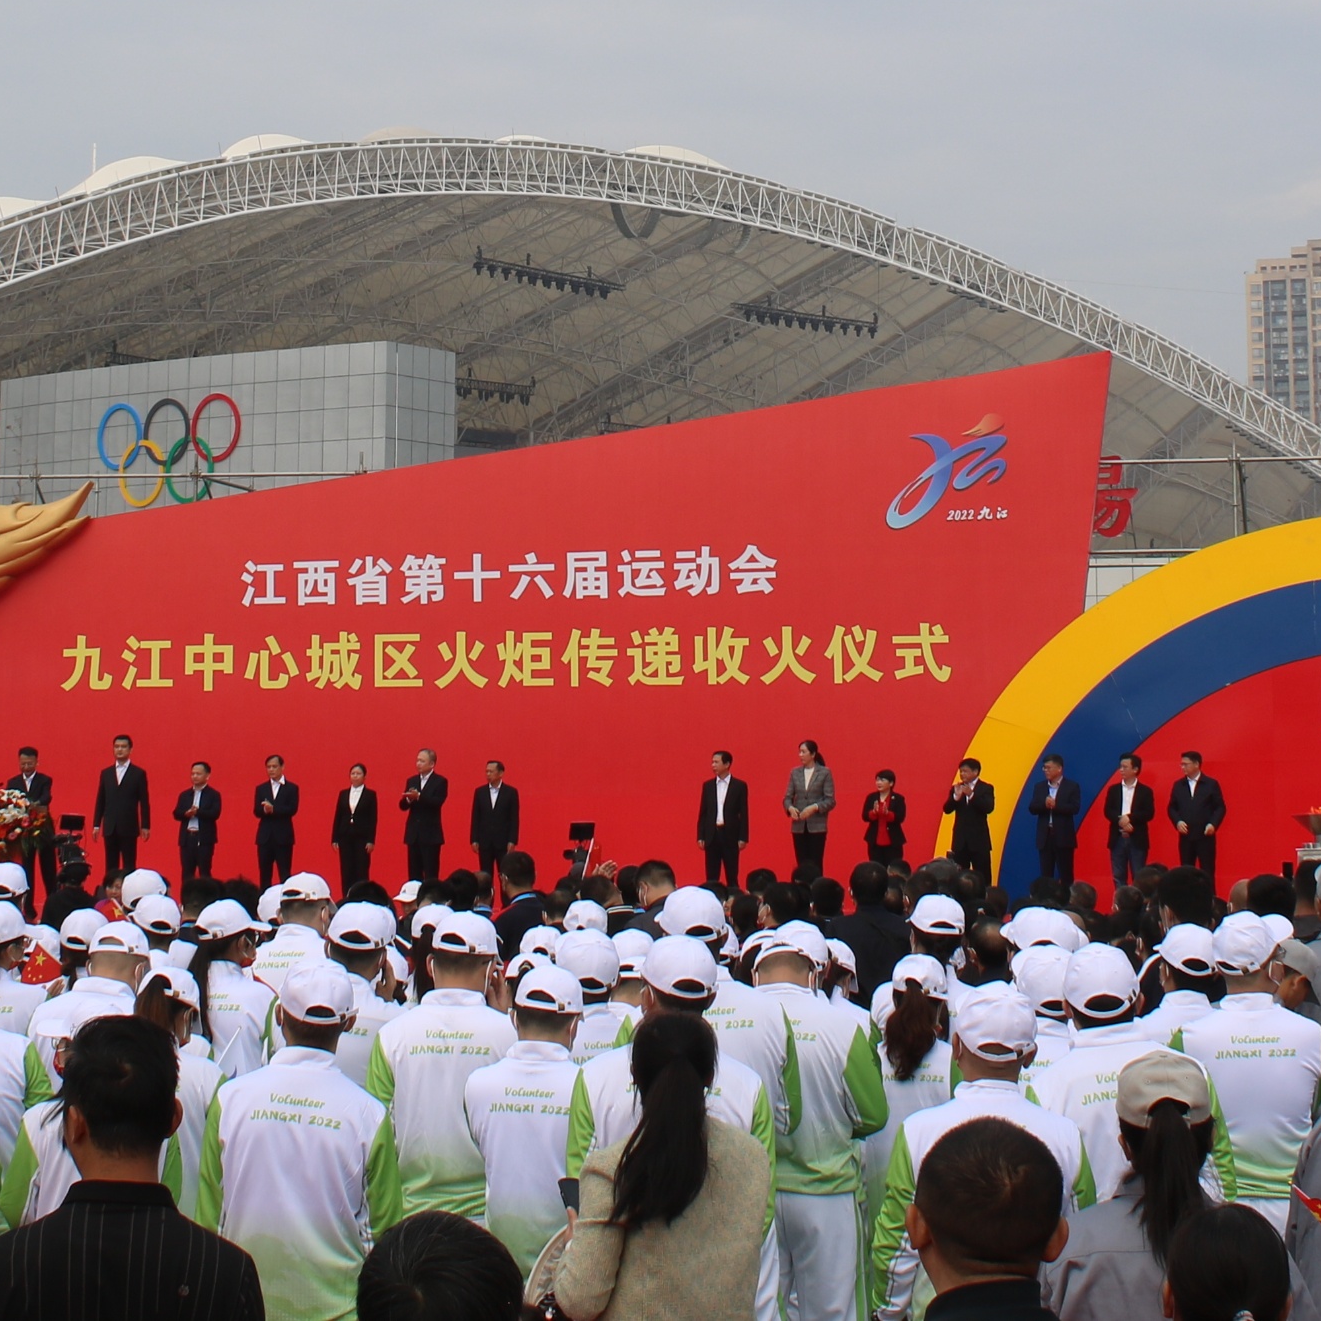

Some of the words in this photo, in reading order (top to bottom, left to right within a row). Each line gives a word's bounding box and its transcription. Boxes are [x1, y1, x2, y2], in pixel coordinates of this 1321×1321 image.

[946, 509, 975, 521] 2022
[241, 544, 777, 607] 江西省第十六届运动会
[60, 622, 952, 691] 九江中心城区火炬传递收火仪式
[268, 950, 306, 958] Volunteer
[255, 961, 290, 969] JIANGXI
[725, 1019, 754, 1029] 2022
[425, 1029, 474, 1040] Volunteer
[1231, 1035, 1280, 1045] Volunteer
[410, 1045, 454, 1055] JIANGXI
[461, 1046, 490, 1056] 2022
[1215, 1049, 1262, 1059] JIANGXI
[1269, 1048, 1297, 1057] 2022
[919, 1074, 944, 1082] 2022
[504, 1086, 555, 1099] Volunteer
[270, 1093, 326, 1109] Volunteer
[489, 1103, 534, 1114] JIANGXI
[541, 1105, 570, 1115] 2022
[250, 1109, 302, 1124] JIANGXI
[308, 1115, 342, 1130] 2022
